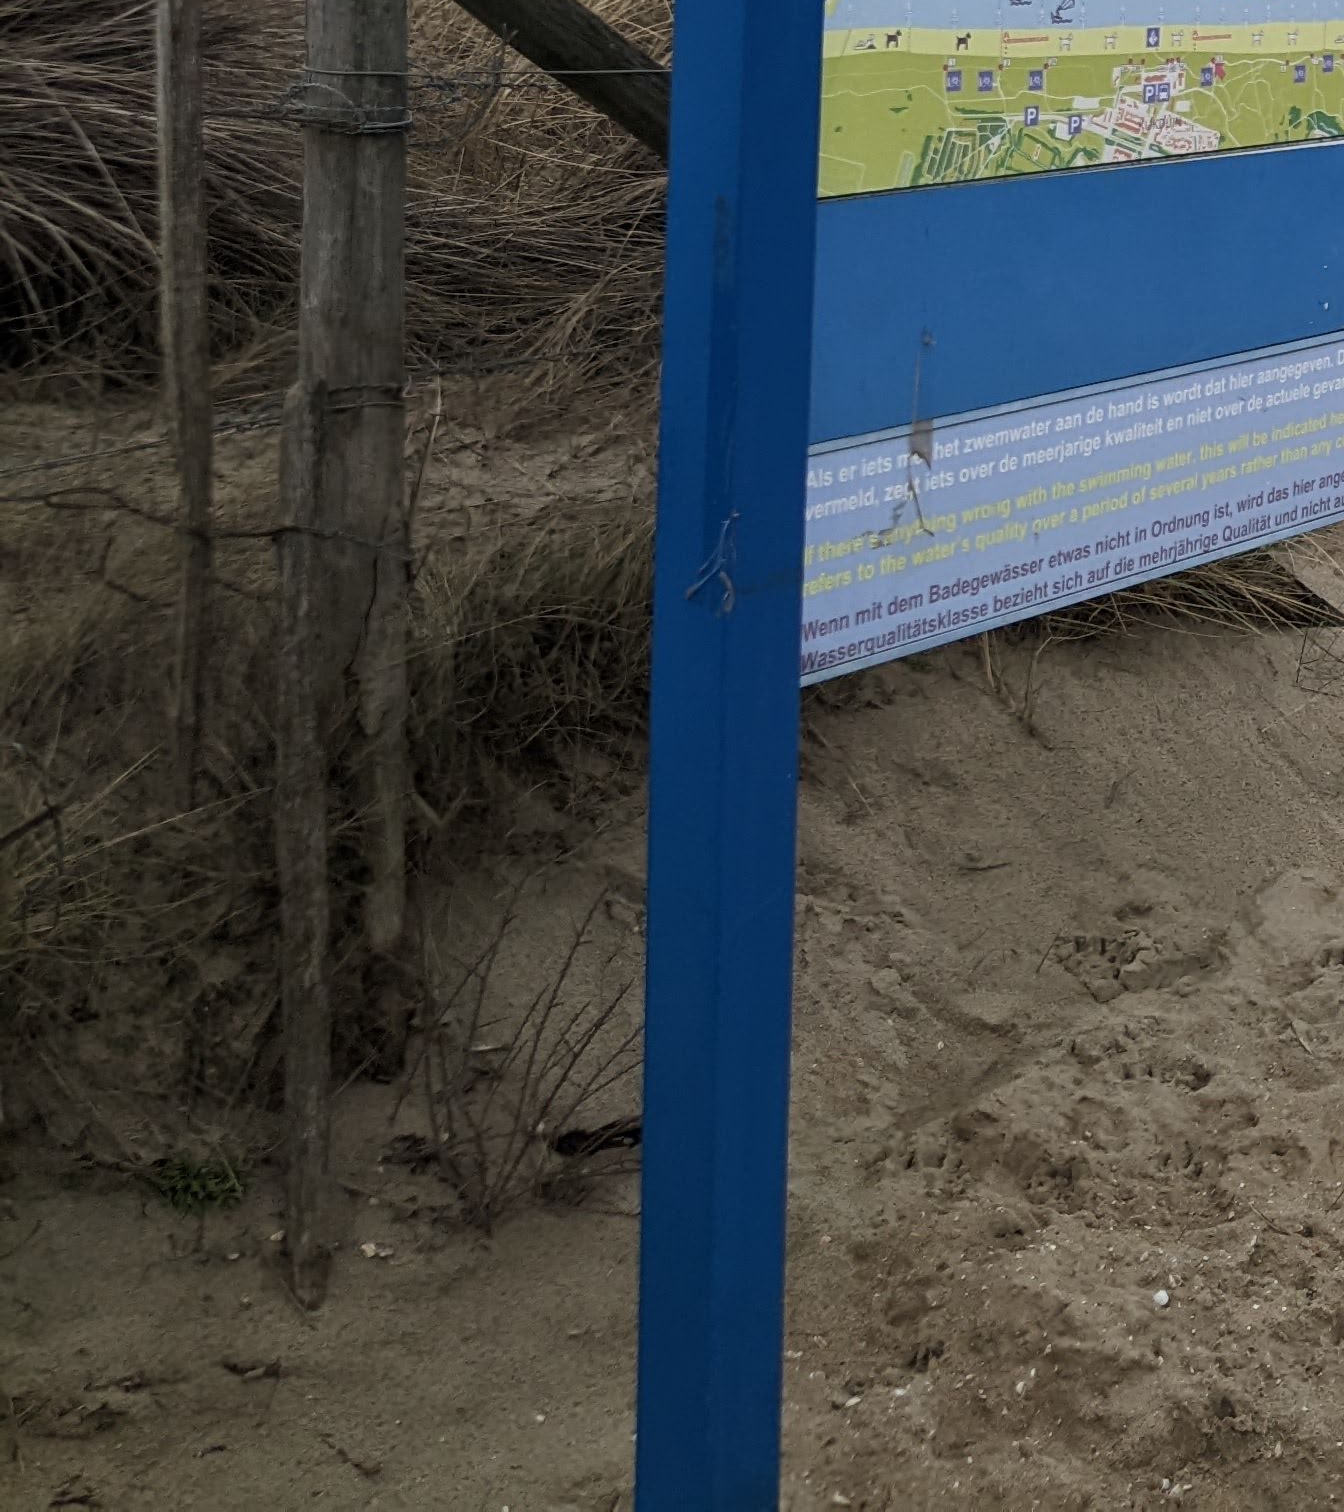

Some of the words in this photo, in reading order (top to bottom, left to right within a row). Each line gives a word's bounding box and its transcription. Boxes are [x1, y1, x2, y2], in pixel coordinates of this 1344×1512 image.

[804, 545, 813, 566] If
[962, 498, 1011, 524] wrong
[1016, 486, 1047, 510] with
[1052, 479, 1075, 500] the
[1080, 460, 1152, 493] swimming
[1200, 441, 1224, 461] this
[1228, 433, 1250, 454] will
[1252, 427, 1268, 447] be
[1271, 413, 1327, 441] indicated
[806, 469, 833, 488] Als
[838, 465, 857, 482] er
[862, 457, 893, 478] iets
[933, 441, 960, 461] het
[963, 418, 1051, 454] zwemwater
[1056, 413, 1081, 433] aan
[1086, 406, 1103, 424] de
[1108, 397, 1142, 419] hand
[1148, 393, 1160, 411] is
[1163, 383, 1202, 407] wordt
[1205, 378, 1226, 397] dat
[1229, 372, 1253, 391] hier
[1257, 355, 1333, 383] aangegeven.
[806, 491, 878, 522] vermeld,
[925, 472, 954, 492] iets
[959, 461, 994, 483] over
[999, 454, 1018, 473] de
[1023, 436, 1101, 467] meerjarige
[1105, 418, 1163, 447] kwaliteit
[1167, 414, 1183, 432] en
[1187, 406, 1212, 427] niet
[1215, 399, 1245, 420] over
[1247, 394, 1263, 413] de
[1266, 381, 1310, 407] actuele
[800, 602, 988, 673] Wasserqualitätsklasse
[993, 582, 1053, 615] bezieht
[1053, 570, 1083, 595] sich
[1087, 562, 1111, 584] auf
[1114, 555, 1135, 577] die
[1139, 533, 1219, 568] mehrjährige
[1222, 514, 1271, 543] Qualität
[1275, 505, 1298, 526] und
[1301, 496, 1331, 520] nicht
[801, 613, 850, 642] Wenn
[855, 602, 883, 627] mit
[888, 592, 924, 617] dem
[929, 557, 1043, 605] Badegewässer
[1048, 543, 1091, 570] etwas
[1095, 530, 1131, 556] nicht
[1135, 526, 1147, 544] in
[1151, 508, 1210, 539] Ordnung
[1214, 500, 1233, 520] ist,
[1236, 492, 1264, 514] wird
[1267, 484, 1290, 504] das
[1293, 478, 1316, 498] hier
[803, 569, 852, 598] refers
[858, 563, 875, 581] to
[880, 554, 907, 576] the
[912, 538, 971, 566] water's
[975, 518, 1027, 551] quality
[1032, 512, 1065, 535] over
[1069, 508, 1079, 523] a
[1083, 492, 1128, 522] period
[1133, 487, 1146, 505] of
[1150, 472, 1198, 501] several
[1202, 464, 1237, 489] years
[1241, 452, 1278, 475] rather
[1281, 445, 1308, 464] than
[1311, 437, 1333, 458] any
